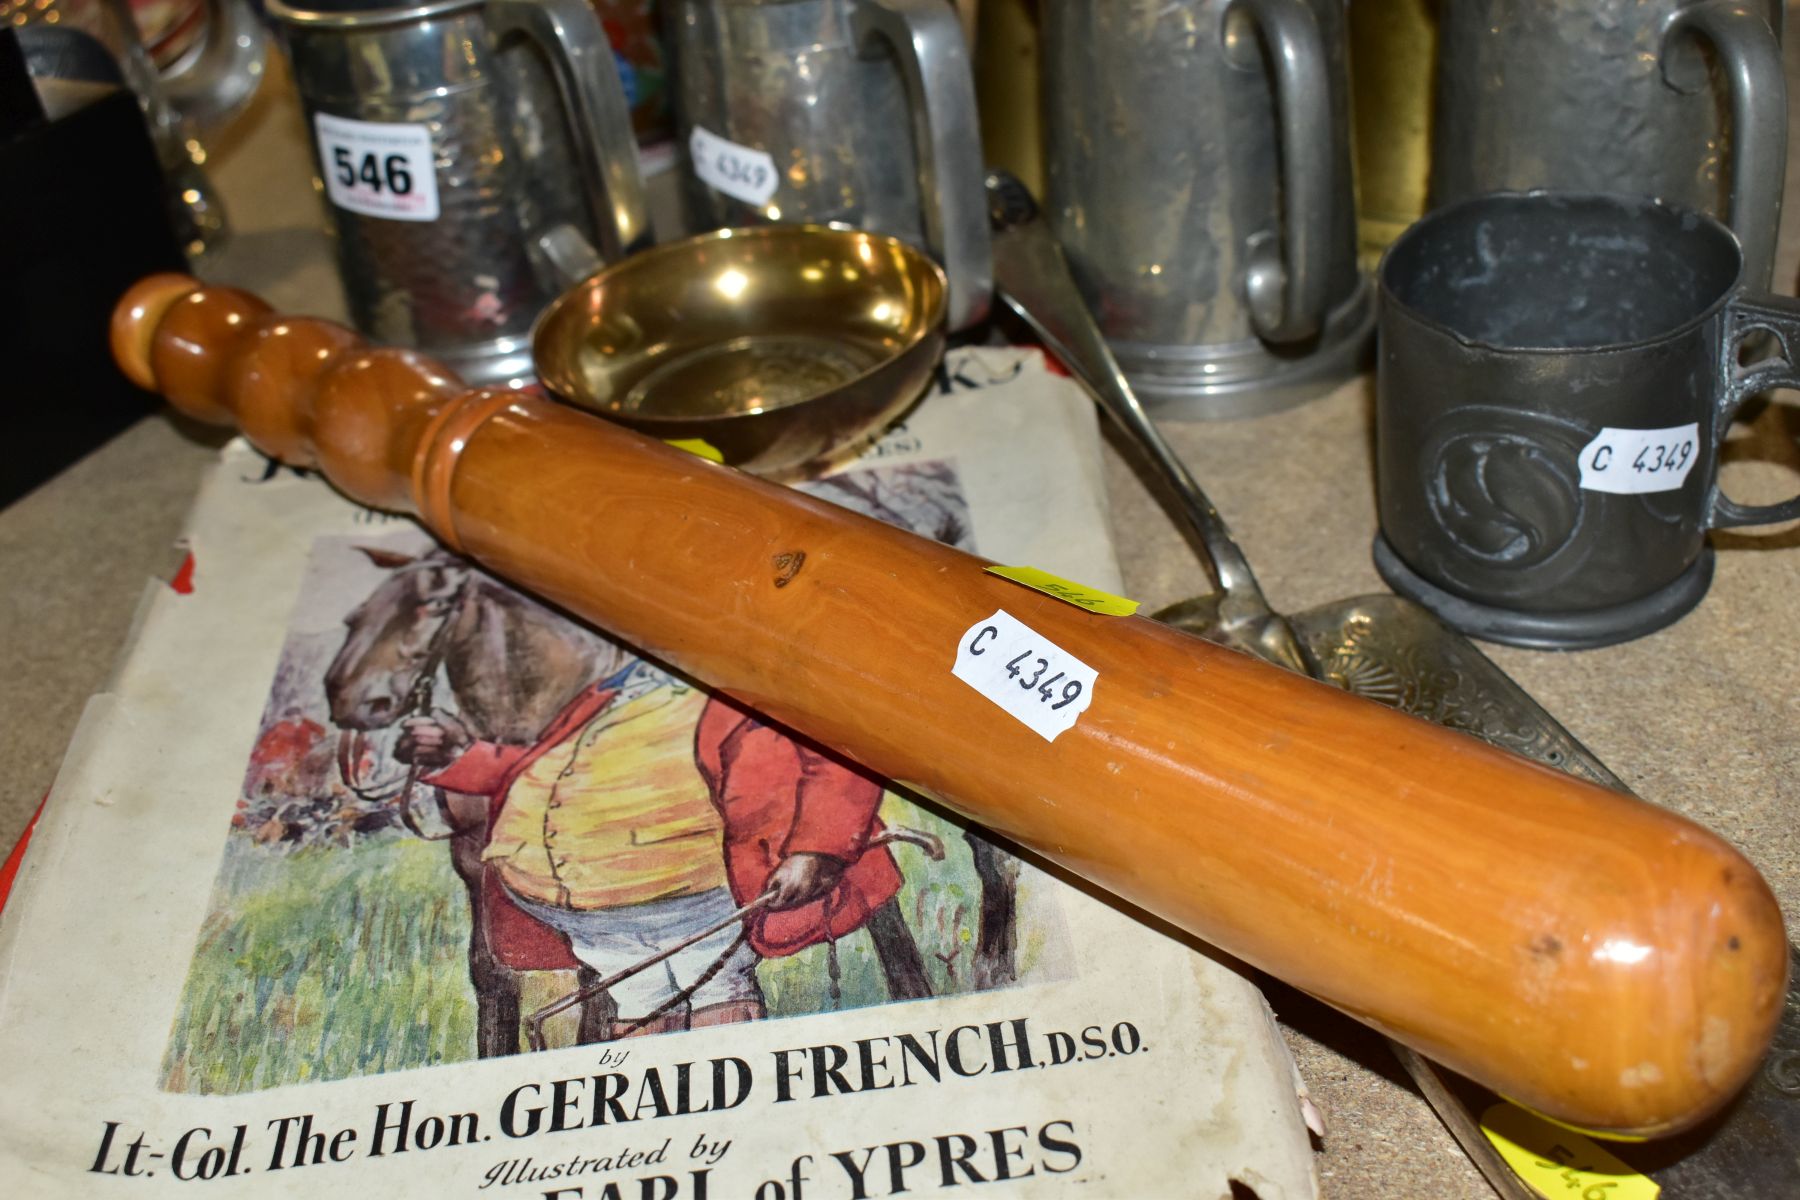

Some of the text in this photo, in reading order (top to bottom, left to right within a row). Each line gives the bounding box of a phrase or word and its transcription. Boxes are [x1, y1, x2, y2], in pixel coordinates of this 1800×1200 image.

[333, 145, 412, 195] 546
[717, 152, 769, 189] 4349
[1591, 440, 1692, 473] C 4349
[969, 625, 1082, 710] C 4349
[598, 1048, 631, 1068] by
[265, 1114, 358, 1172] The
[499, 1056, 753, 1139] GERALD
[478, 1133, 733, 1189] Illustrated by
[829, 1119, 1082, 1200] YPRES
